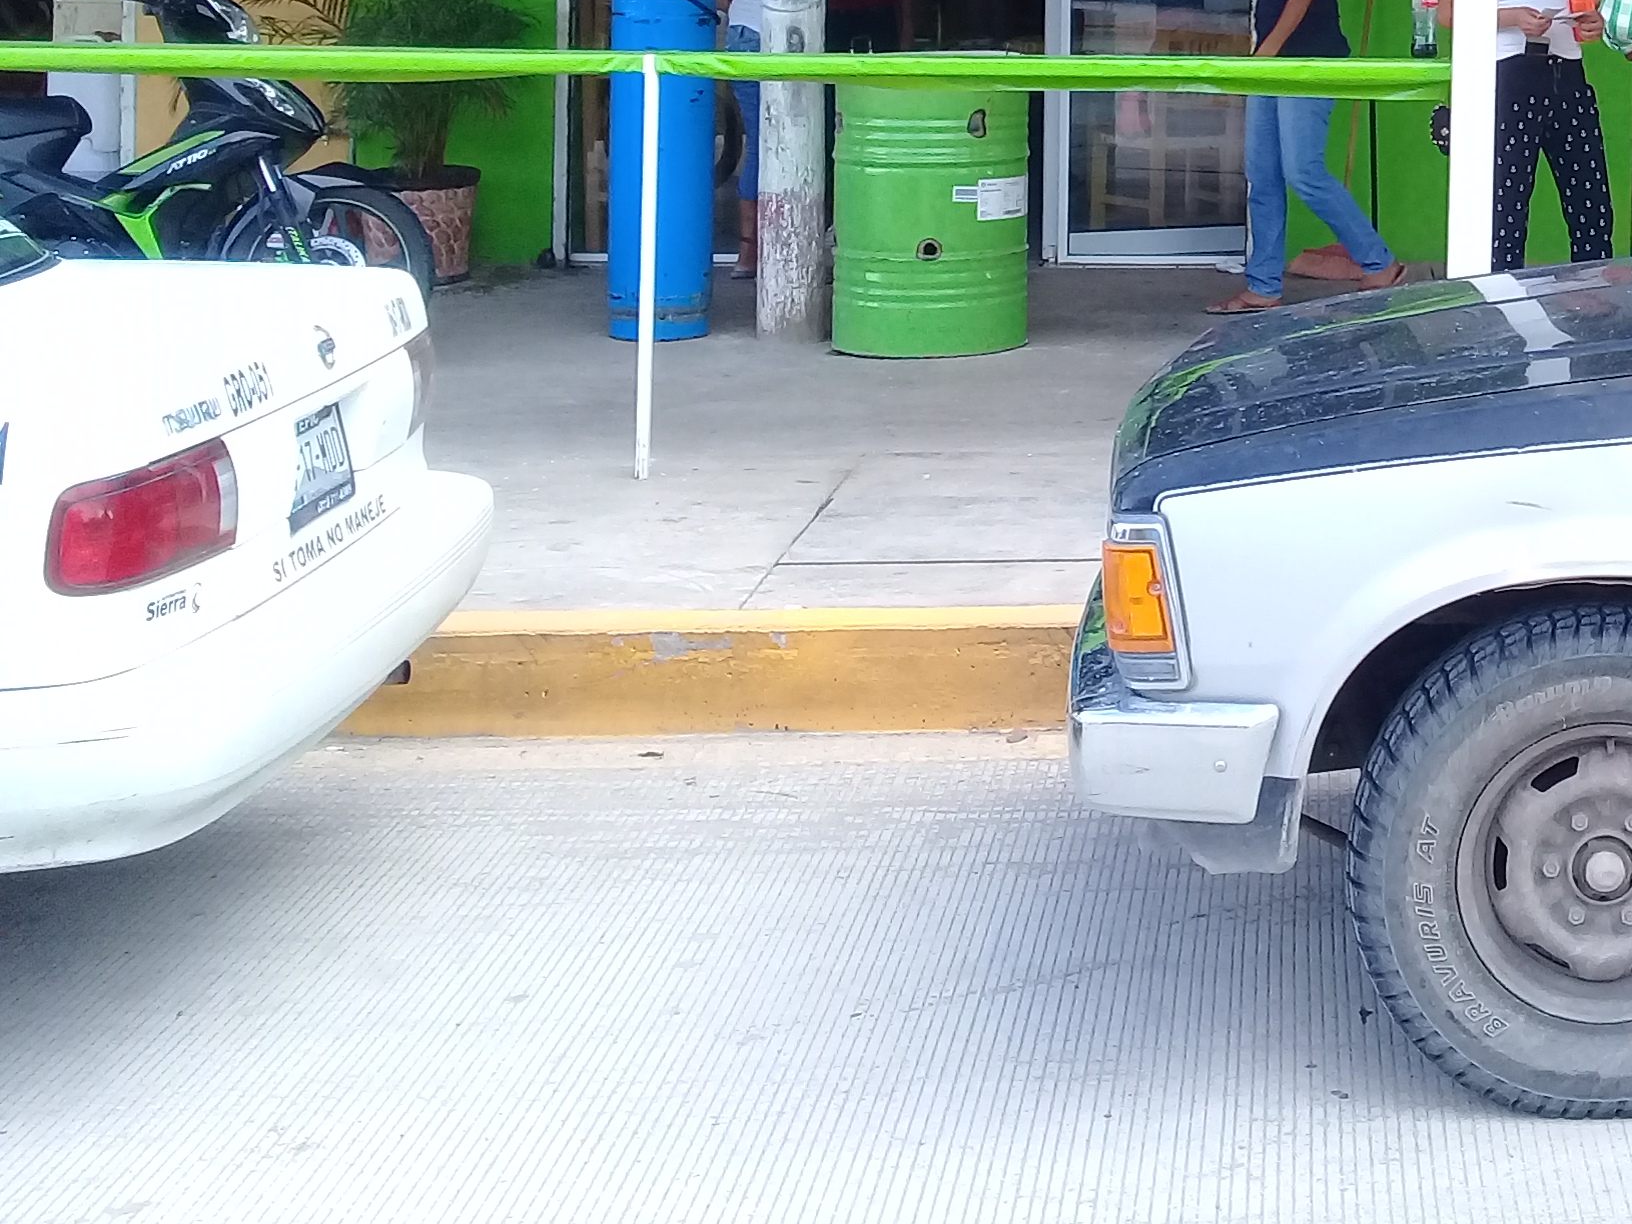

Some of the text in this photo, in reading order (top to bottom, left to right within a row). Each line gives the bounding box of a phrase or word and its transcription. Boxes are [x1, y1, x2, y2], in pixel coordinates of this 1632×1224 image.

[272, 557, 288, 583] SI
[288, 534, 327, 572] TOMA
[326, 522, 344, 549] NO
[344, 493, 387, 536] MANEJE
[145, 595, 187, 622] Sierra
[1413, 813, 1510, 1038] BRAVURIS AT
